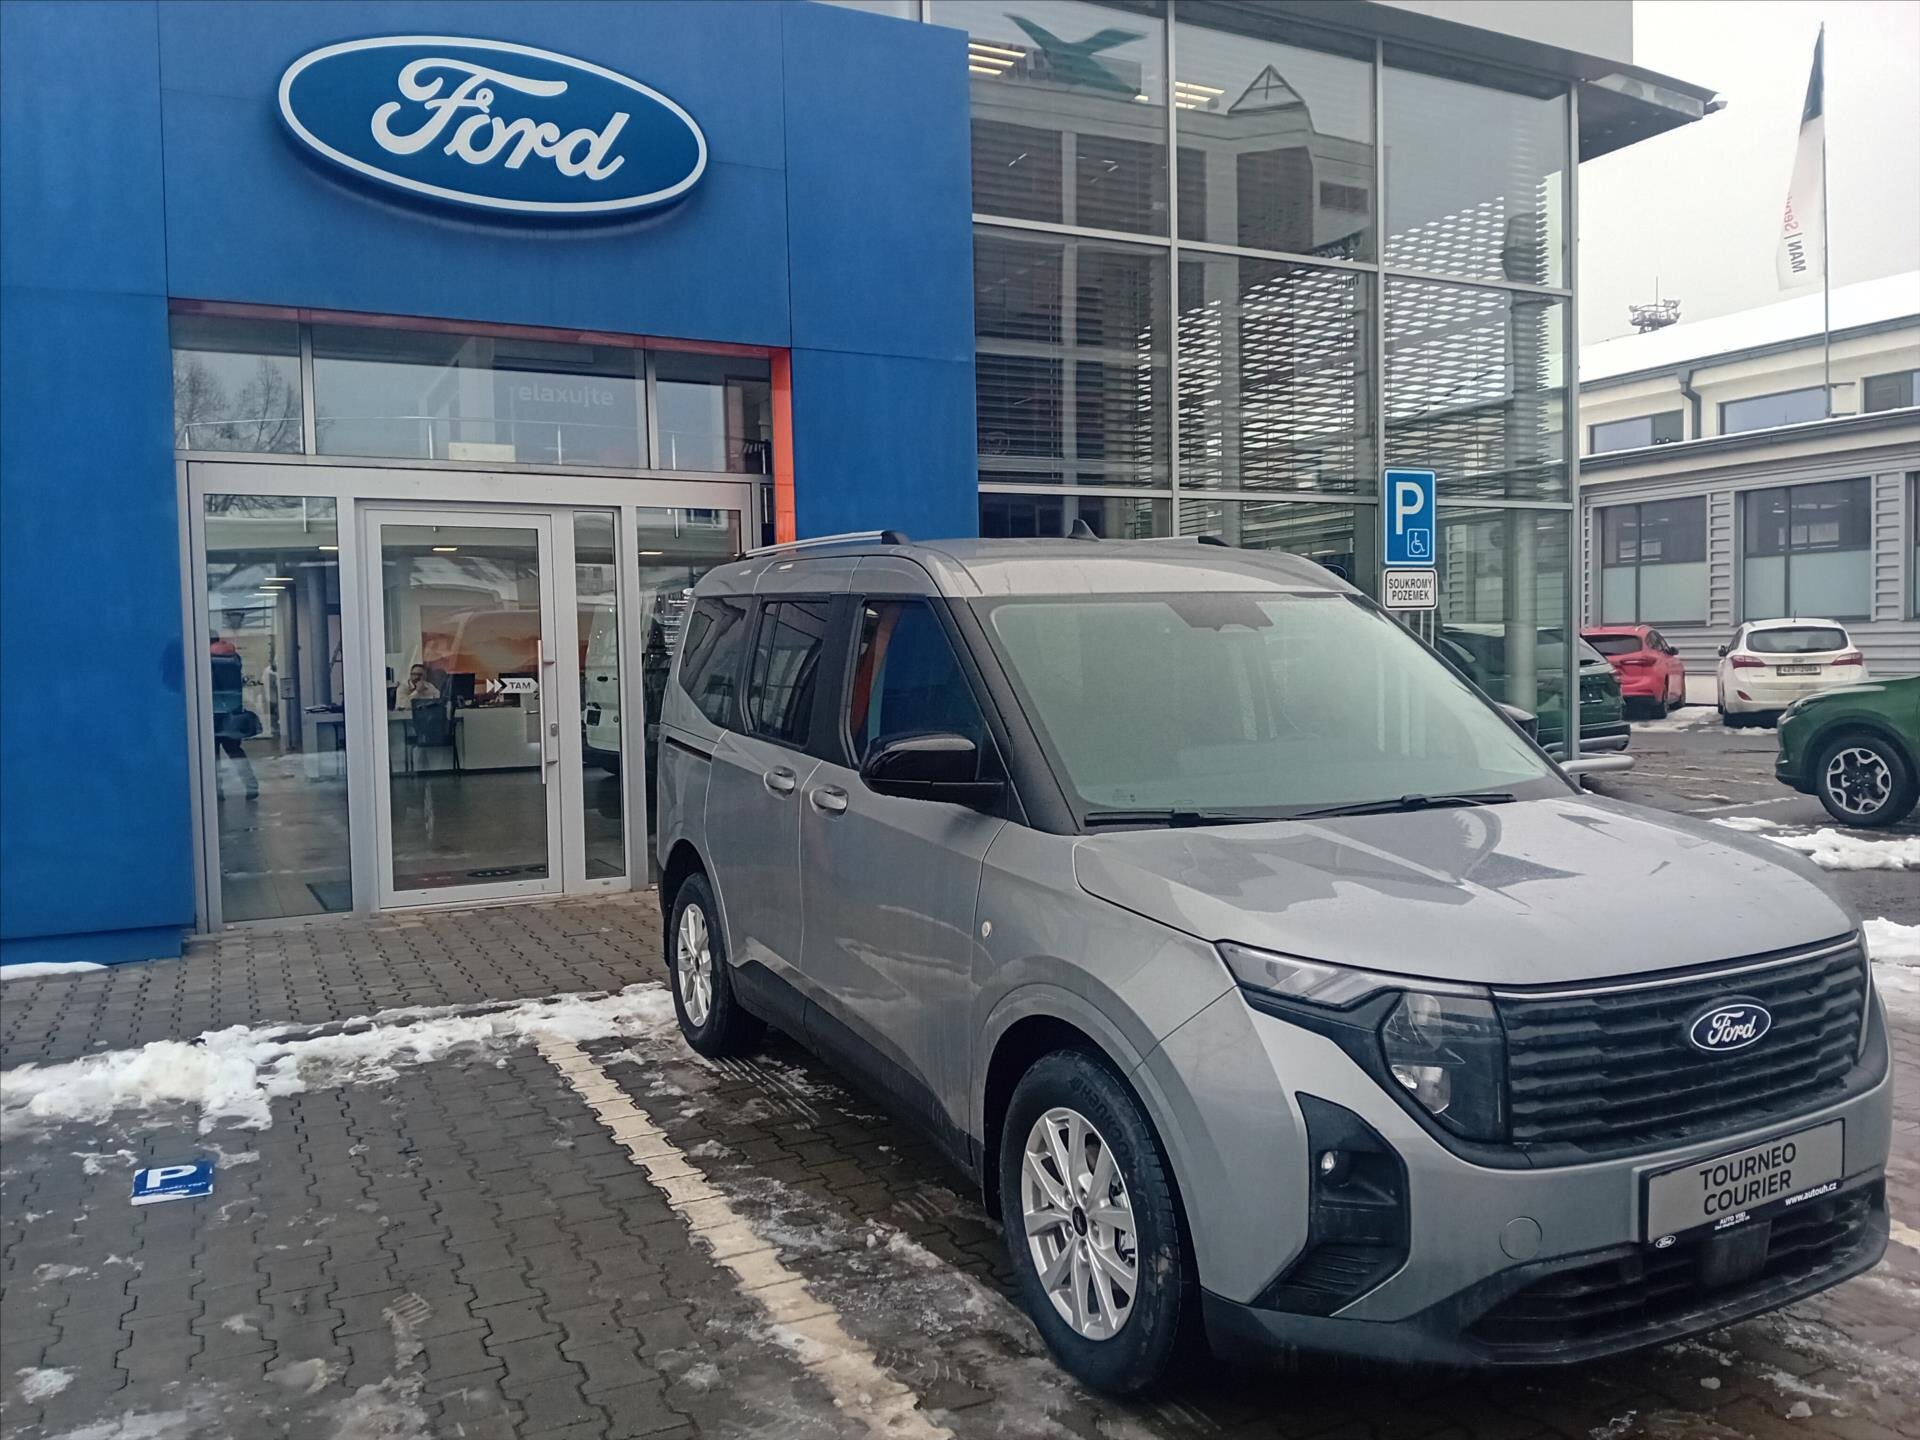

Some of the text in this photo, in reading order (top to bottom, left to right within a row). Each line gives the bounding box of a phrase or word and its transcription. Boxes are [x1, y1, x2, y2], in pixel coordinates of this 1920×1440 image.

[371, 57, 630, 181] Ford
[1396, 481, 1425, 535] P
[1392, 590, 1430, 601] POZEMEK
[509, 681, 531, 690] TAM
[1707, 1011, 1757, 1045] Ford
[146, 1165, 197, 1189] P
[1700, 1142, 1797, 1190] TOURNEO
[1703, 1169, 1792, 1215] COURIER
